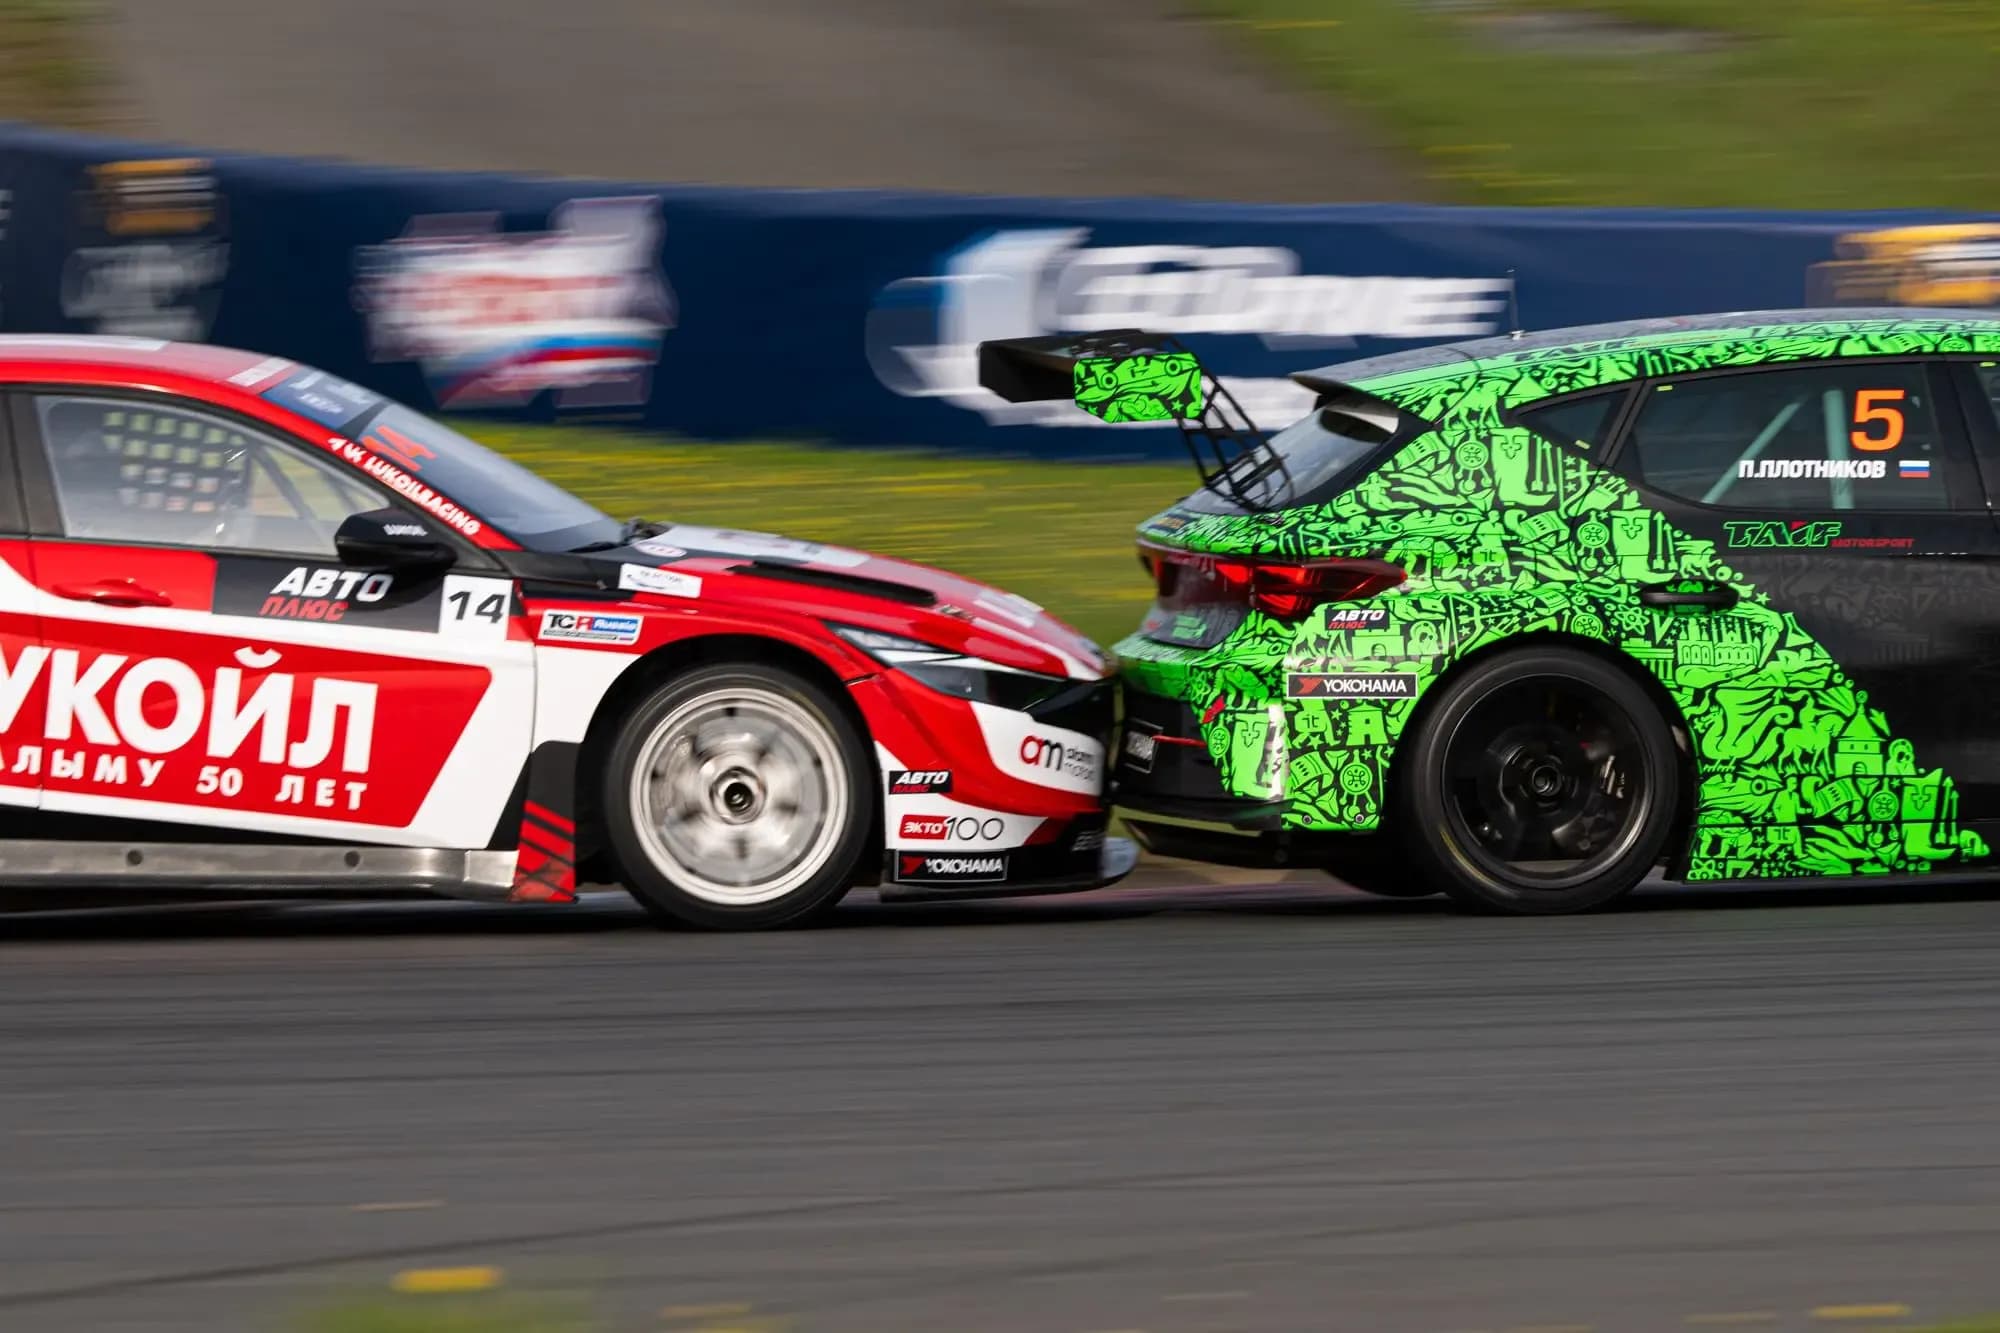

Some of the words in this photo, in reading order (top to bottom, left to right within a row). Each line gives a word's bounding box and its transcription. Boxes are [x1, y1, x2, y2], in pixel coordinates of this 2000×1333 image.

[1851, 389, 1905, 452] 5
[1738, 460, 1887, 479] П.ПЛОТНИКОВ
[1831, 538, 1915, 548] MOTORSPORT
[270, 567, 394, 602] АВТО
[259, 596, 349, 622] ПЛЮС
[449, 591, 507, 624] 14
[1332, 609, 1386, 621] АВТО
[1328, 621, 1368, 630] ПЛЮС
[1323, 679, 1407, 693] YOKOHAMA
[895, 771, 949, 785] АВТО
[195, 765, 244, 797] 50
[274, 774, 368, 810] ЛЕТ
[925, 858, 1003, 874] YOKOHAMA
